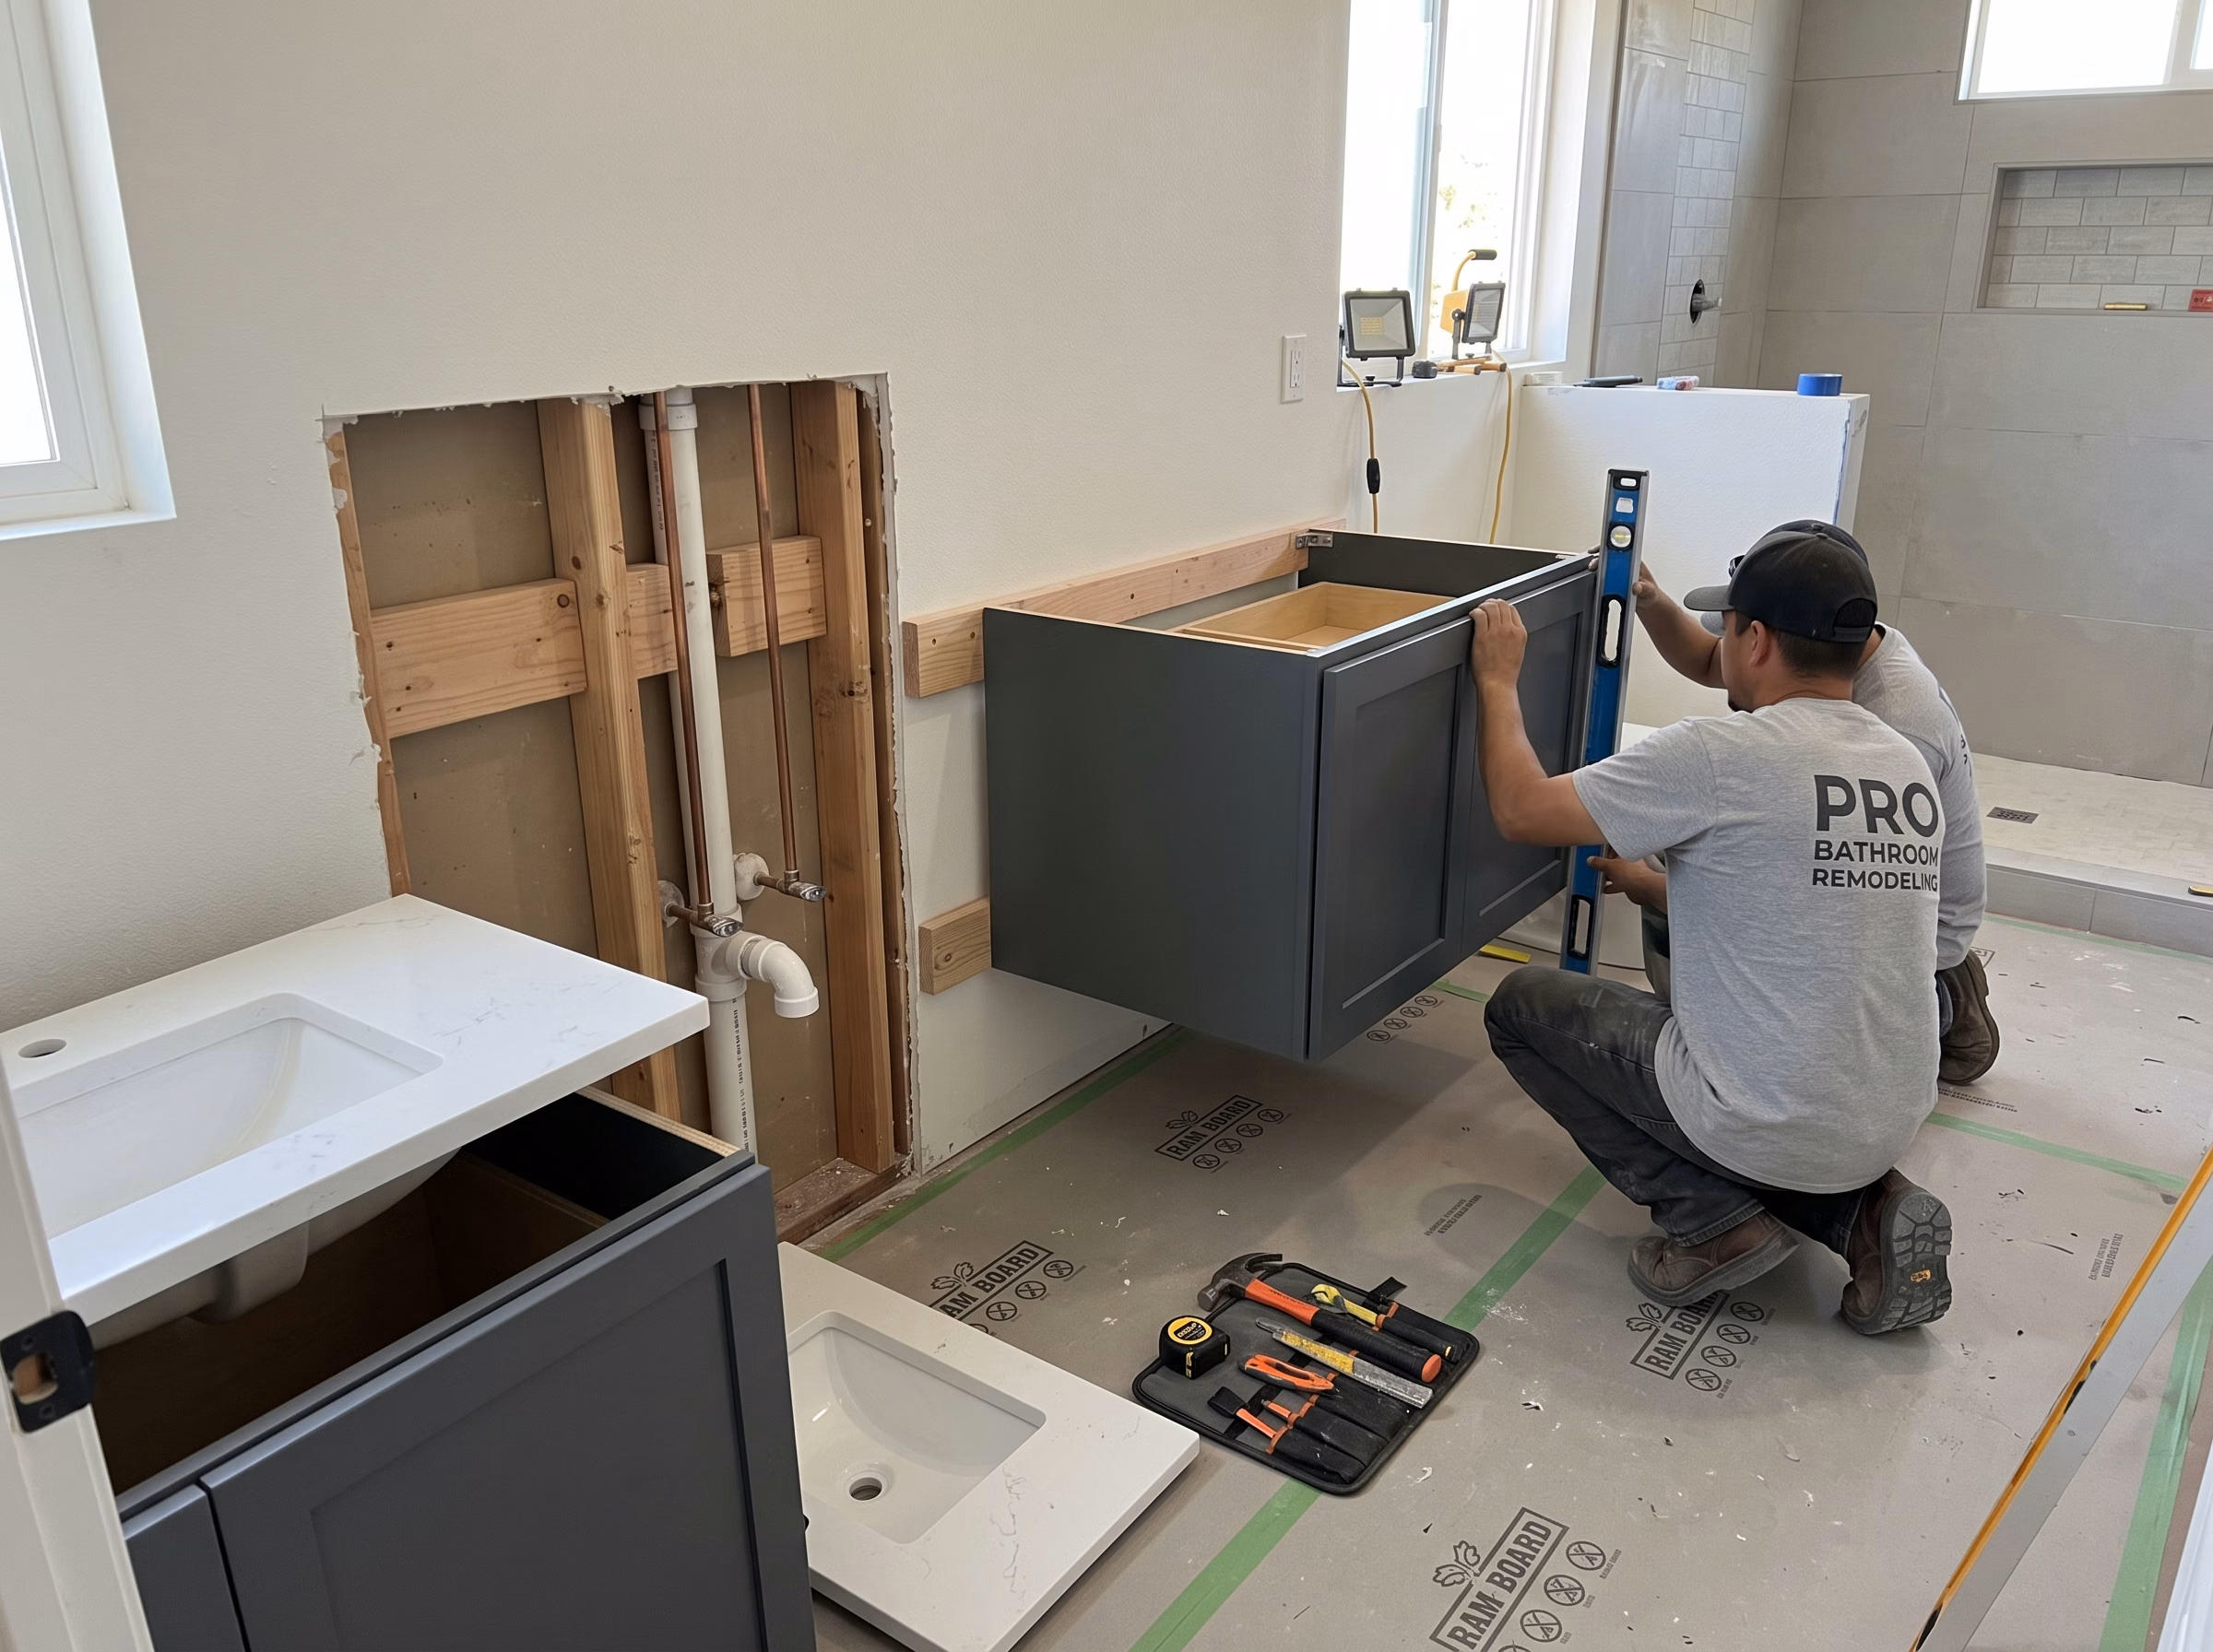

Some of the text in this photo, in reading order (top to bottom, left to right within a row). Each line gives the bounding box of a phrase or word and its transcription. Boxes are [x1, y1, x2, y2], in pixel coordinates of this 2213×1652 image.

[1814, 774, 1938, 837] PRO
[1812, 868, 1937, 891] REMODELING
[1814, 839, 1938, 867] BATHROOM
[1166, 1130, 1208, 1156] RAM
[1201, 1100, 1251, 1131] BOARD
[939, 1292, 978, 1317] AM
[972, 1247, 1039, 1293] BOARD
[1644, 1332, 1687, 1371] RAM
[1447, 1520, 1552, 1649] RAM BOARD
